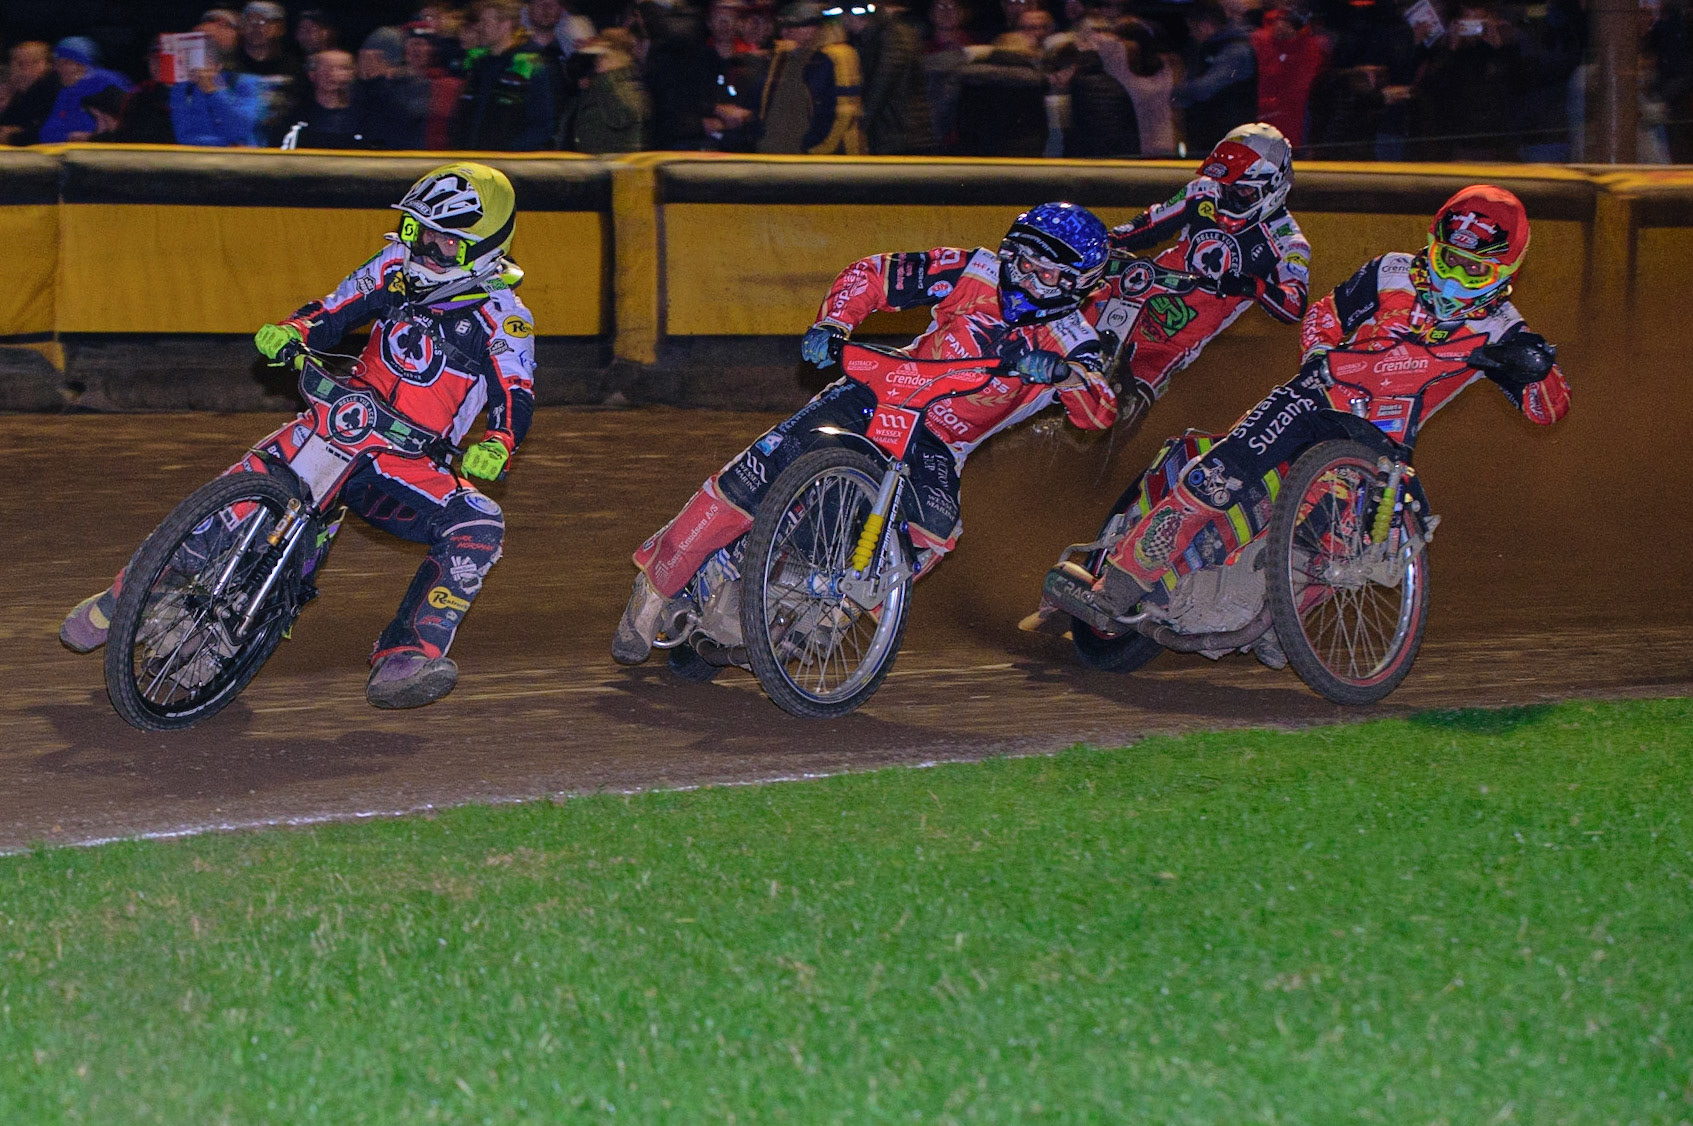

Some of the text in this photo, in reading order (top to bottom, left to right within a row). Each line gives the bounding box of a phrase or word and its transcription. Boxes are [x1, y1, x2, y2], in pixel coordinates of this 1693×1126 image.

[1195, 233, 1220, 244] BELLE
[1221, 234, 1236, 249] VUE
[1373, 357, 1429, 373] Crendon
[872, 436, 899, 445] MARINE
[875, 428, 902, 438] WESSEX
[679, 518, 708, 551] Knudsen
